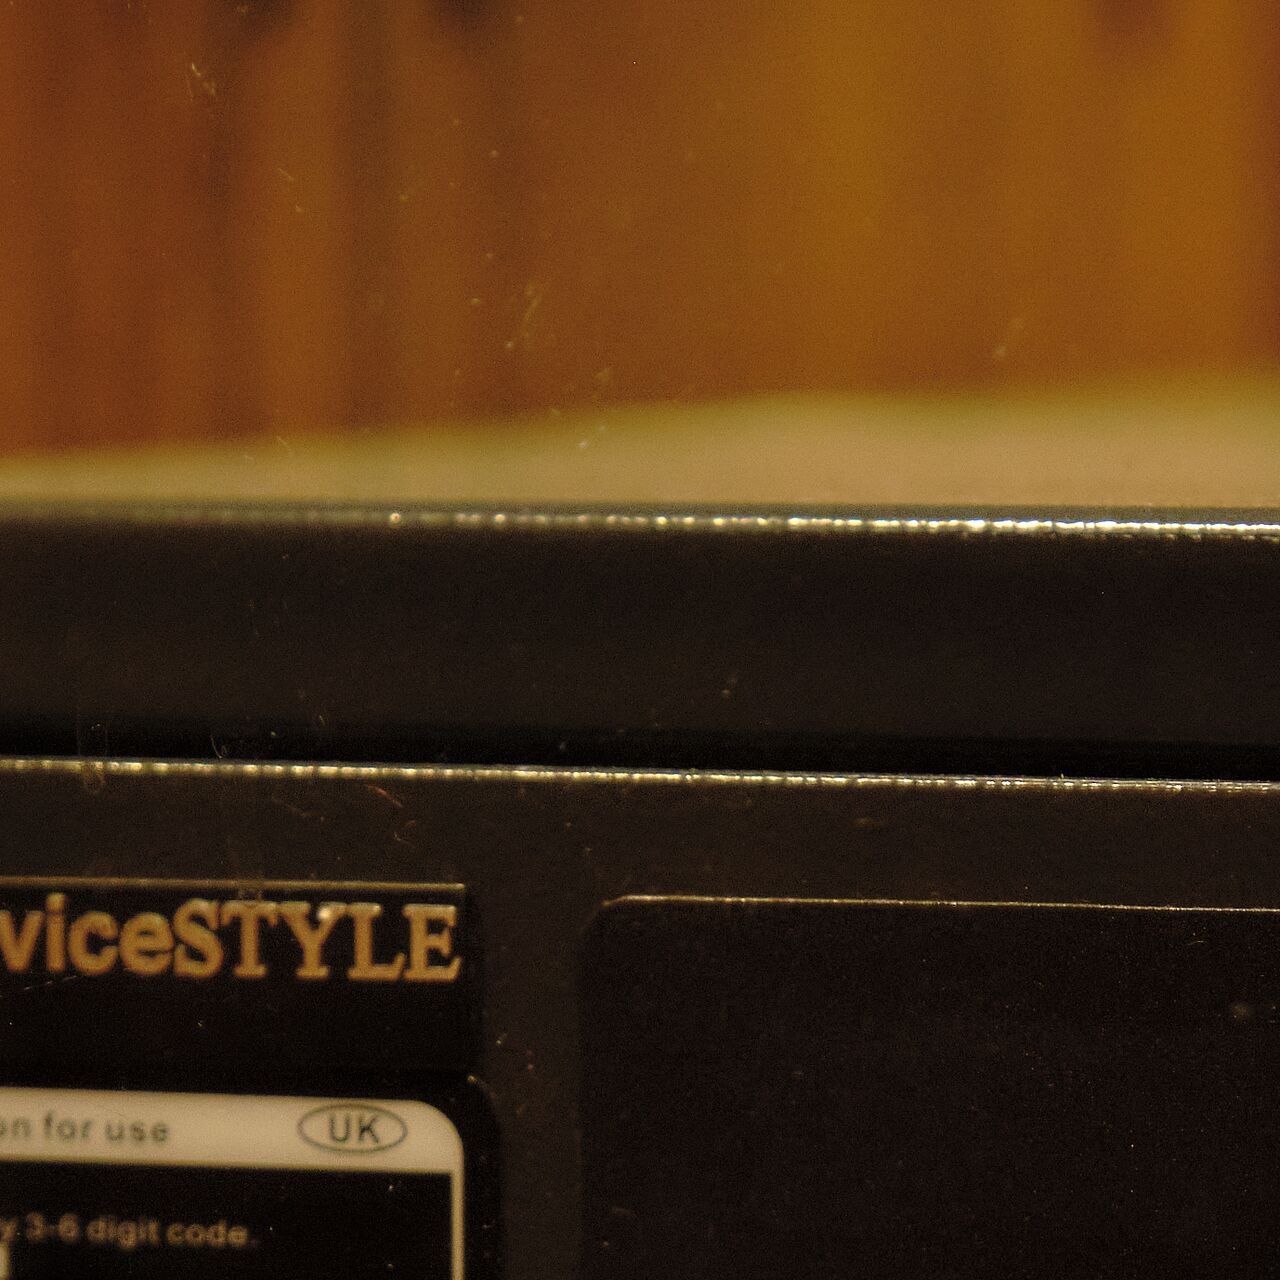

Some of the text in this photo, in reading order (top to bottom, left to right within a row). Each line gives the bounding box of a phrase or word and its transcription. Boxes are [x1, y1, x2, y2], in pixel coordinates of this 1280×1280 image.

[43, 1109, 93, 1140] for
[104, 1118, 169, 1144] use
[328, 1112, 382, 1146] UK
[24, 1211, 80, 1242] 3-6
[85, 1214, 161, 1250] digit
[165, 1218, 258, 1248] code.
